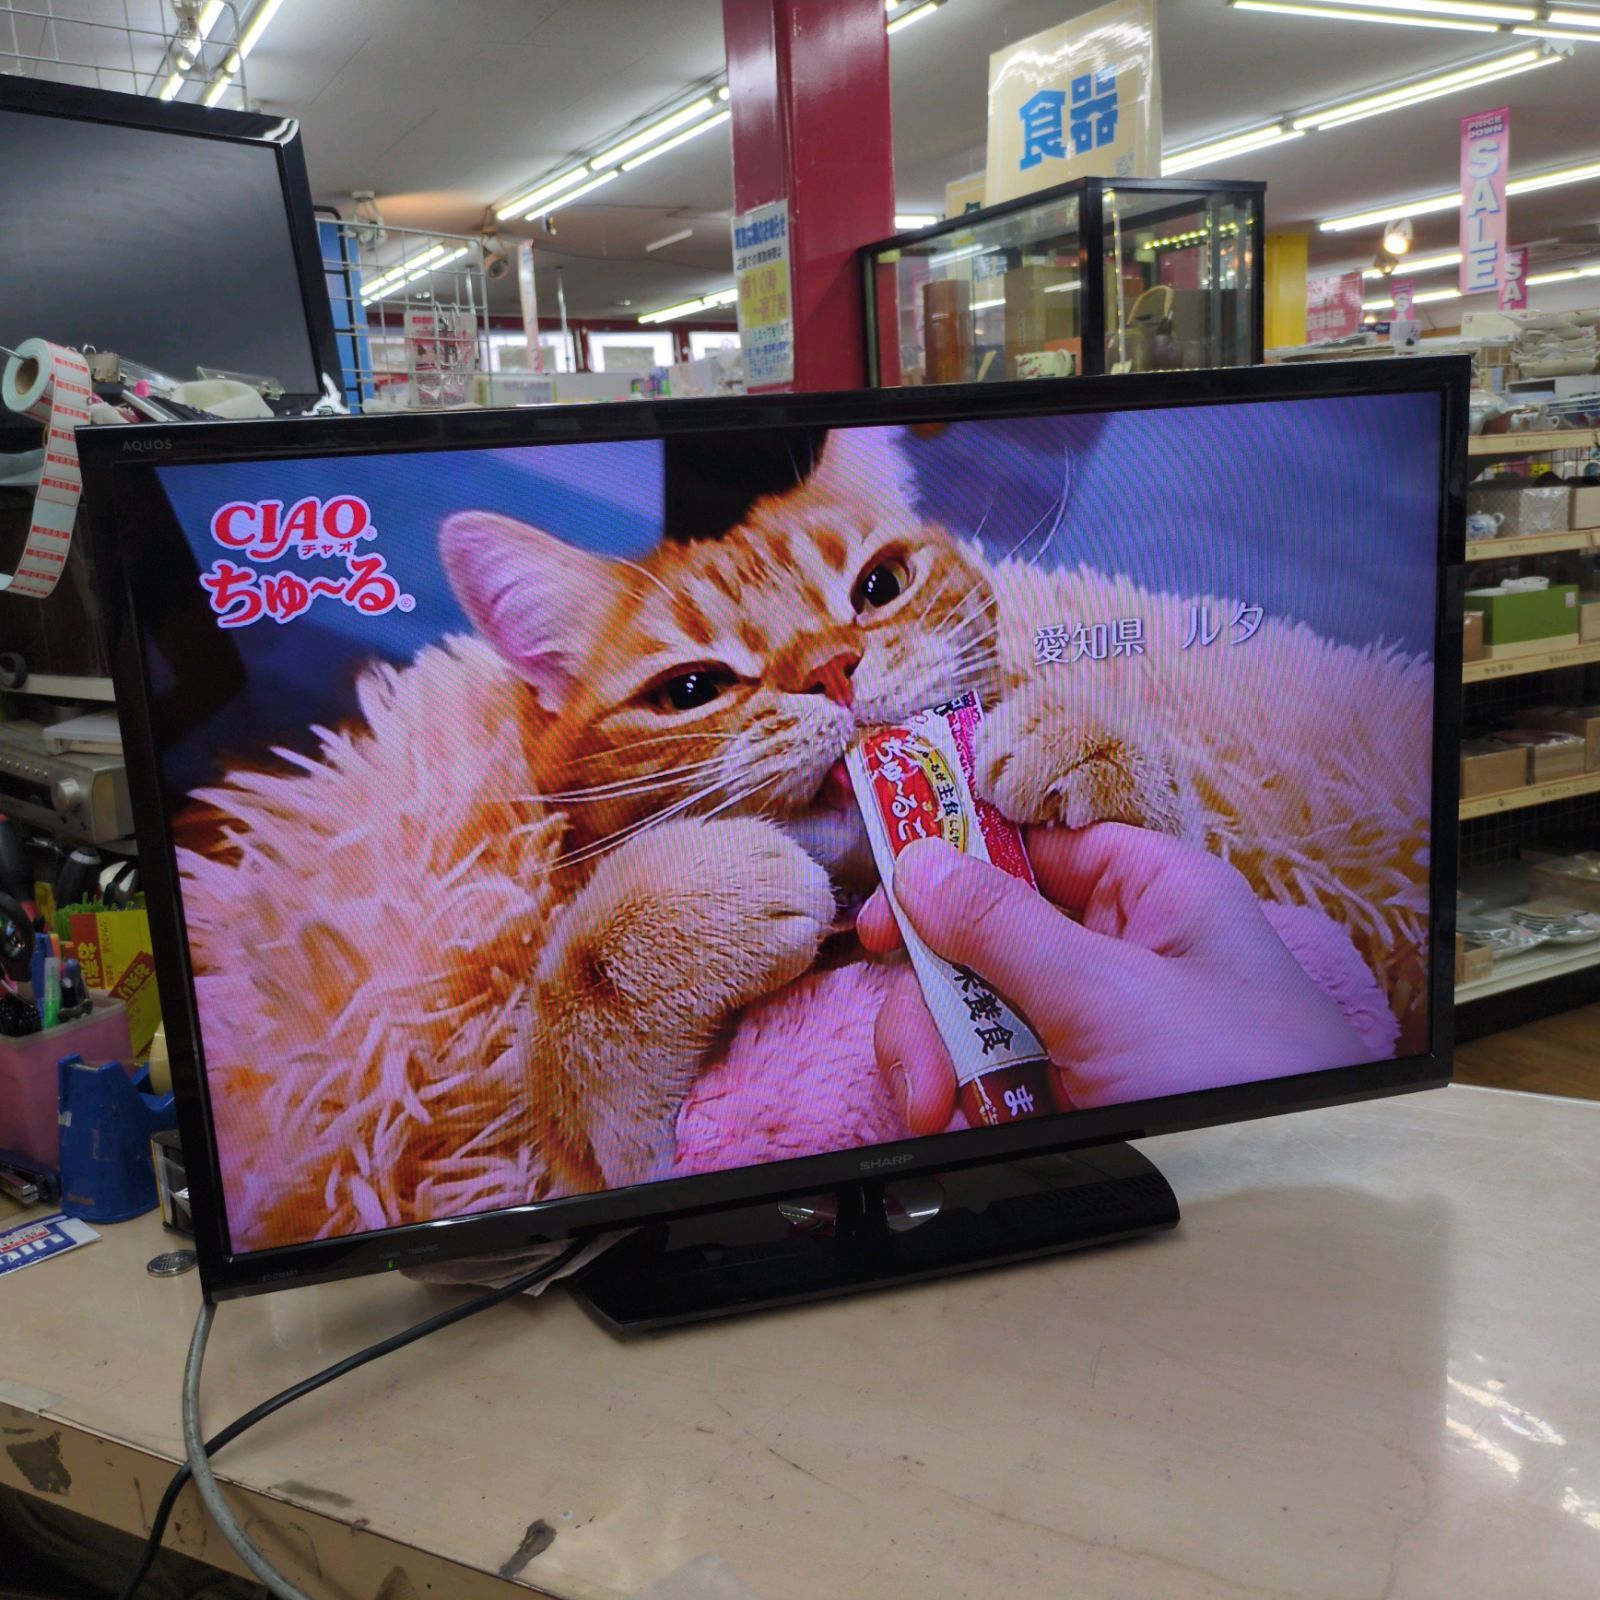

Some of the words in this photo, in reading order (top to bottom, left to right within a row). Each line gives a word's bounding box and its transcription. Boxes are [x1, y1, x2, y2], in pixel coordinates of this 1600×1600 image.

[1018, 65, 1119, 171] 食器
[1467, 115, 1503, 130] PRICE
[1467, 123, 1504, 141] DOWN
[1467, 139, 1501, 291] SALE
[122, 439, 173, 453] AQUOS
[213, 497, 368, 560] CIAO
[301, 542, 352, 556] チャオ
[1033, 617, 1146, 666] 愛知県
[1181, 601, 1264, 649] ルタ
[859, 1153, 914, 1170] SHARP
